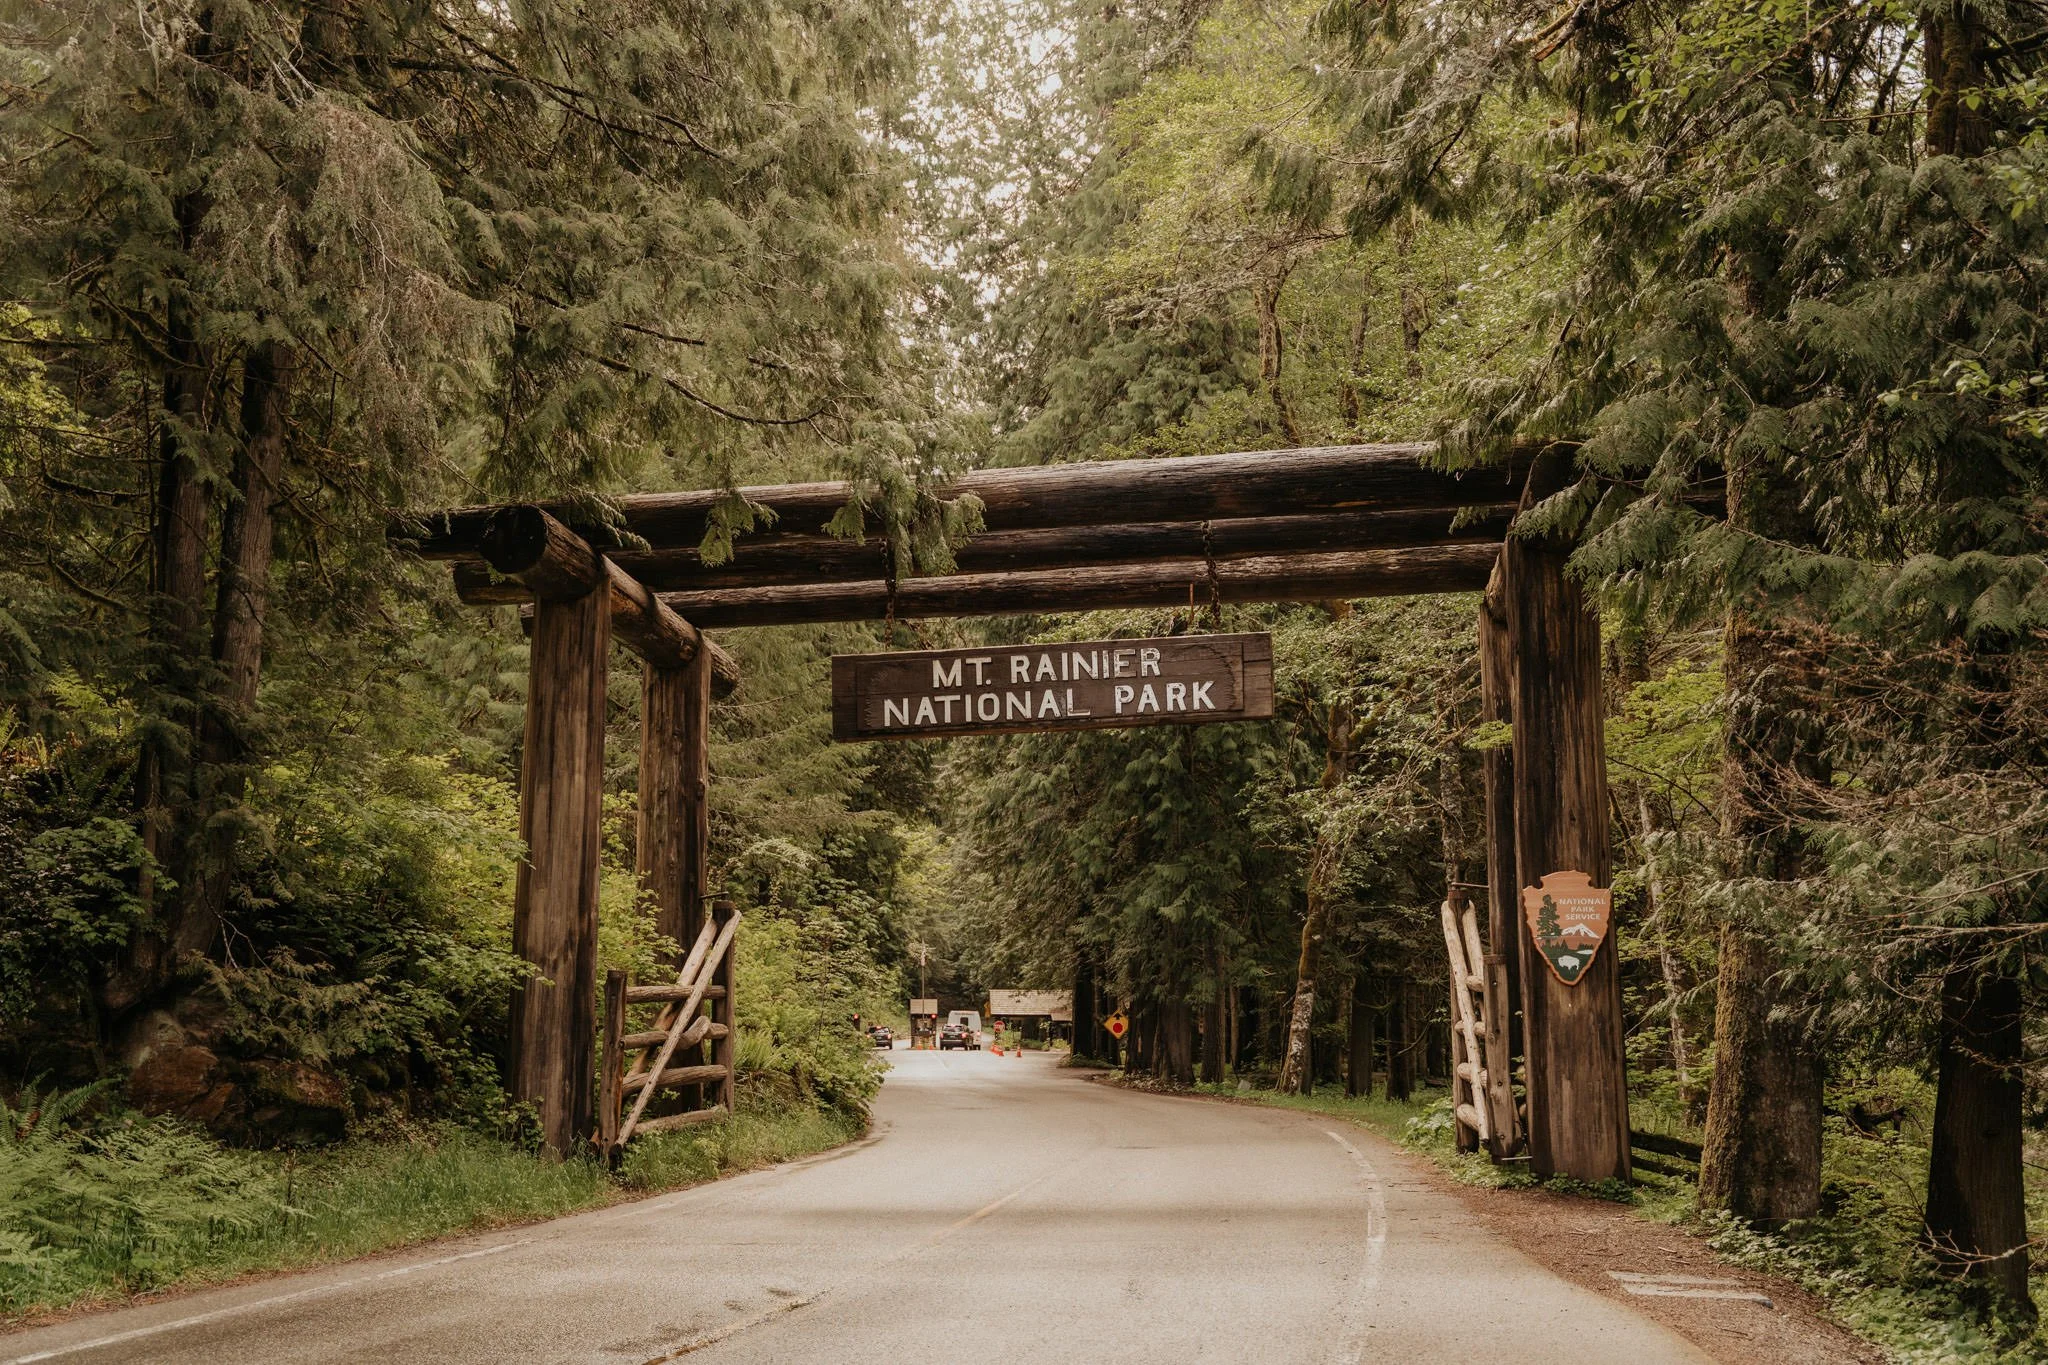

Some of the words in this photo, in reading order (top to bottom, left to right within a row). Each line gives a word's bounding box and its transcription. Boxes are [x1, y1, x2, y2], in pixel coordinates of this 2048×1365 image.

[932, 657, 992, 688] MT.
[1010, 647, 1161, 684] RAINIER
[884, 688, 1091, 727] NATIONAL
[1114, 680, 1217, 714] PARK
[1559, 897, 1607, 905] NATIONAL
[1570, 905, 1595, 913] PARK
[1565, 913, 1601, 921] SERVICE
